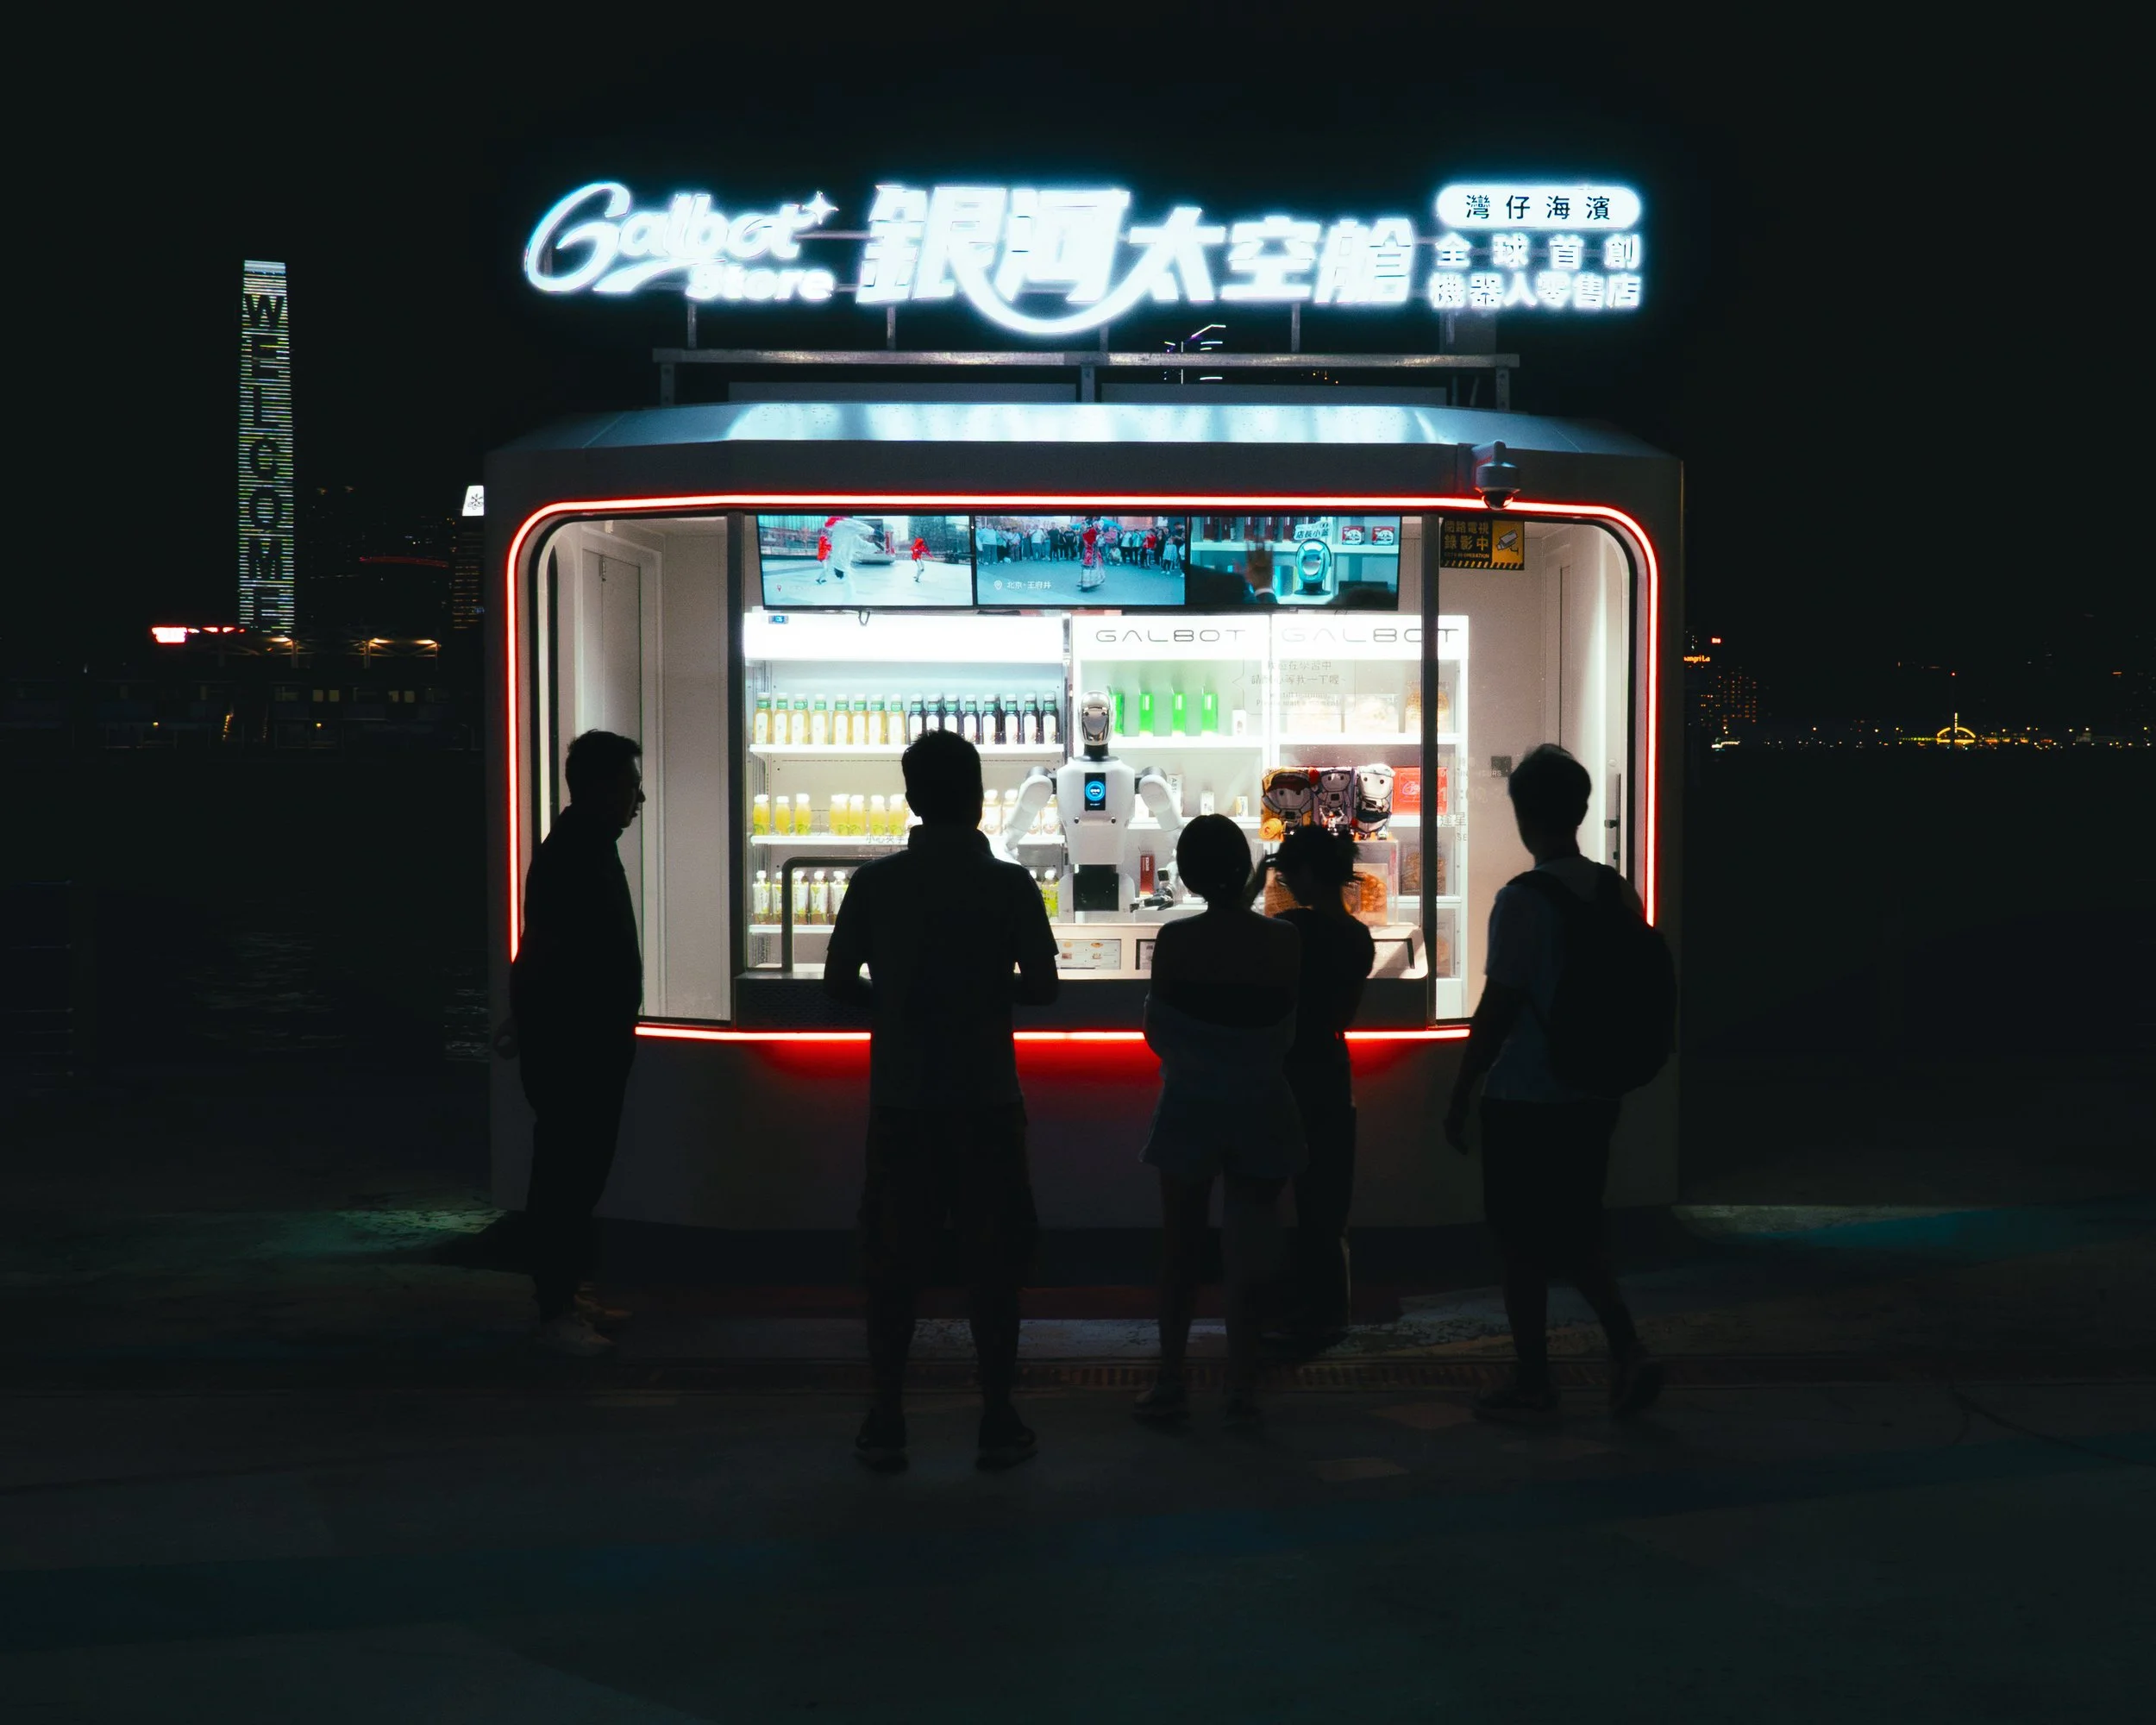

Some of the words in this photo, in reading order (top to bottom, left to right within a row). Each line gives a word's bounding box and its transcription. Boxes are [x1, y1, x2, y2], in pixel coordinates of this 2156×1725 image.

[1465, 194, 1611, 221] 灣仔海濱
[523, 182, 816, 293] Galbot
[1434, 232, 1641, 269] 全球首創
[856, 185, 1414, 334] 銀河太空艙
[686, 265, 834, 300] Store
[1428, 271, 1642, 309] 機器人零售店
[242, 294, 288, 629] WELCOME
[1095, 630, 1245, 643] GALBOT
[1282, 628, 1459, 643] GALBOT
